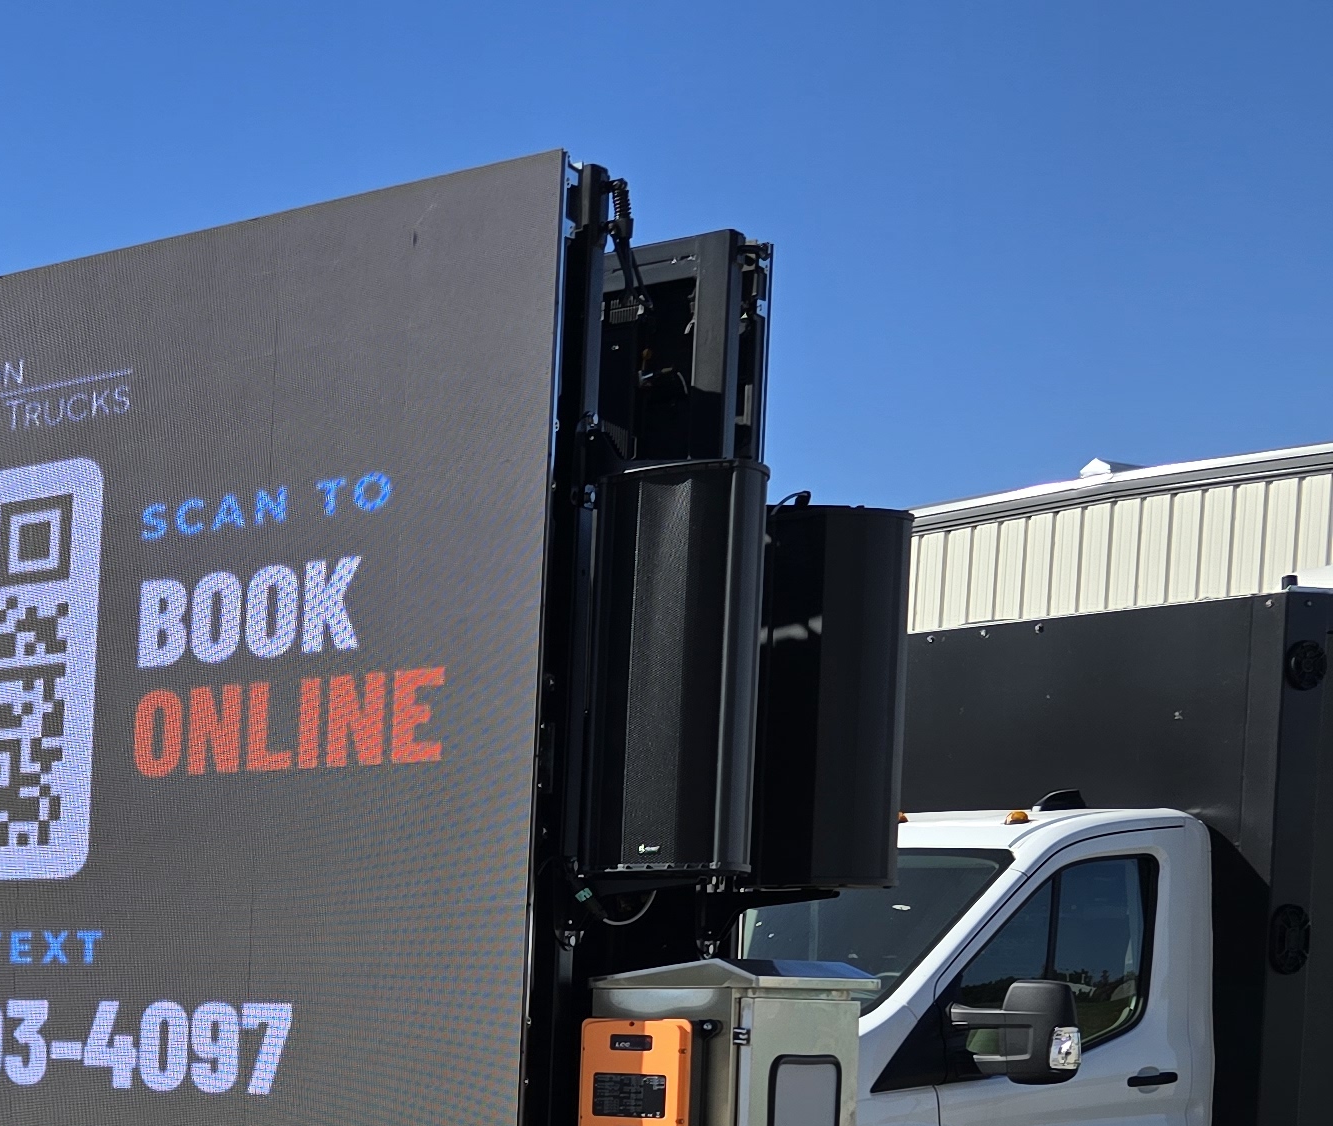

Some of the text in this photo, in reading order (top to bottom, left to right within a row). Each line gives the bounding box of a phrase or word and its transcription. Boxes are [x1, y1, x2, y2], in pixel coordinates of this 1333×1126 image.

[6, 385, 131, 431] TRUCKS
[141, 471, 392, 540] SCAN TO
[138, 555, 362, 669] BOOK
[133, 667, 445, 778] ONLINE
